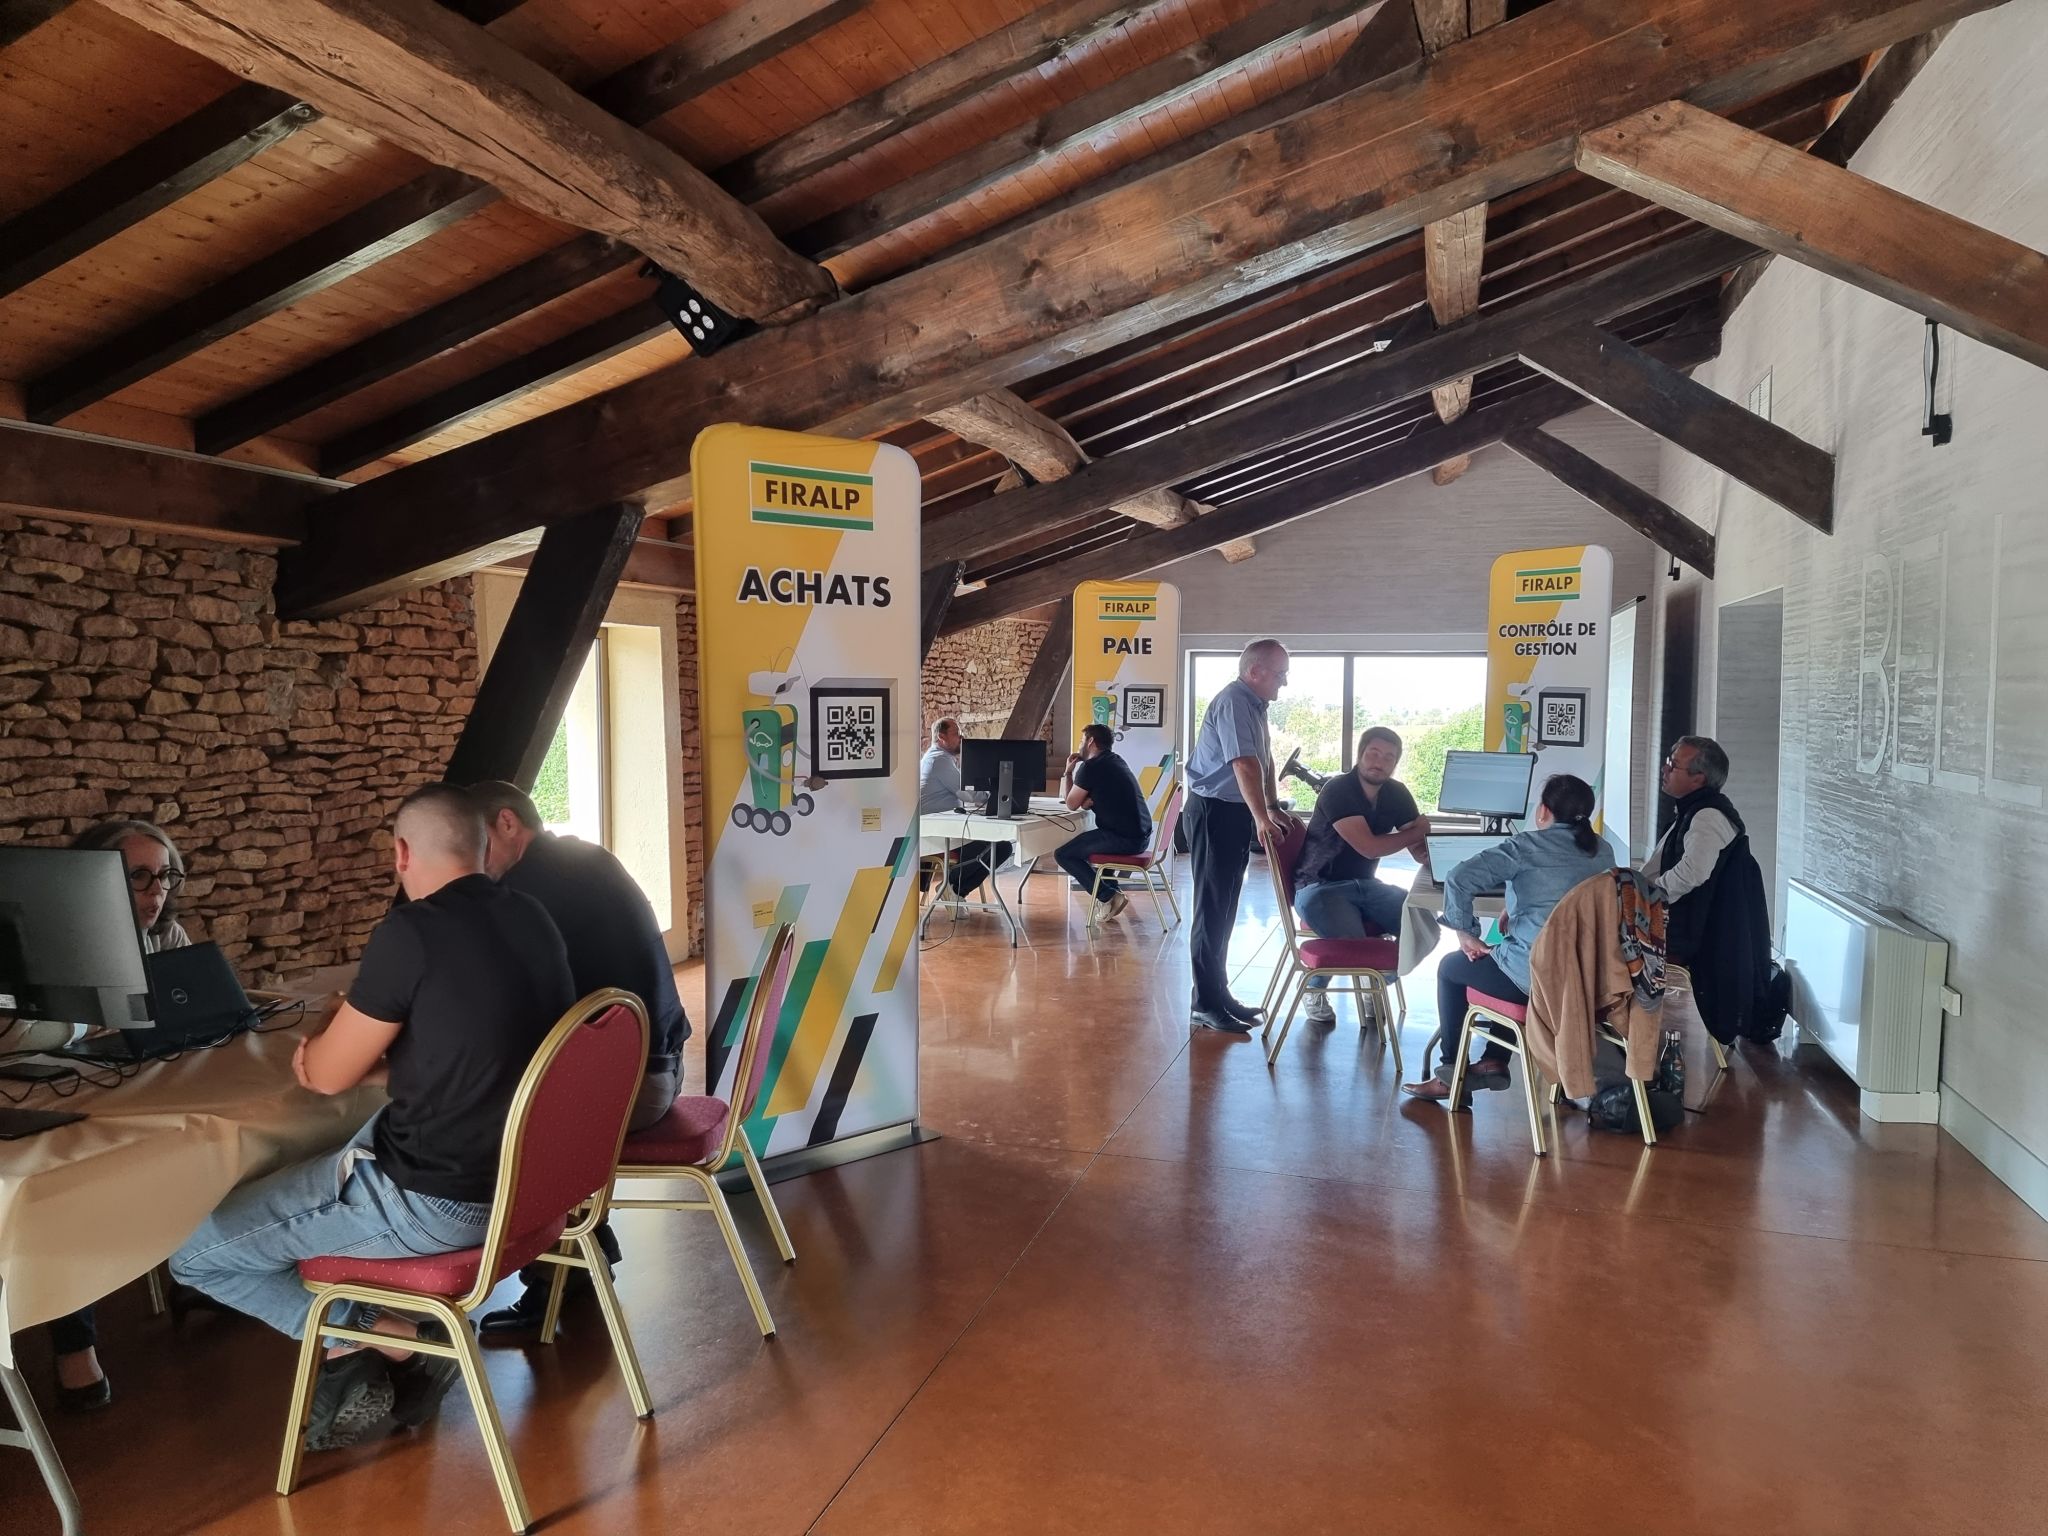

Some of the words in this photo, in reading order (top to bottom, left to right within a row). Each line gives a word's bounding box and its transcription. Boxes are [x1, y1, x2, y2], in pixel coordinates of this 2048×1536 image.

[765, 479, 860, 511] FIRALP
[738, 568, 892, 608] ACHATS
[1522, 576, 1573, 591] FIRALP
[1105, 602, 1150, 613] FIRALP
[1499, 619, 1573, 638] CONTRÔLE
[1578, 622, 1596, 636] DE
[1103, 637, 1152, 655] PAIE
[1514, 642, 1577, 656] GESTION
